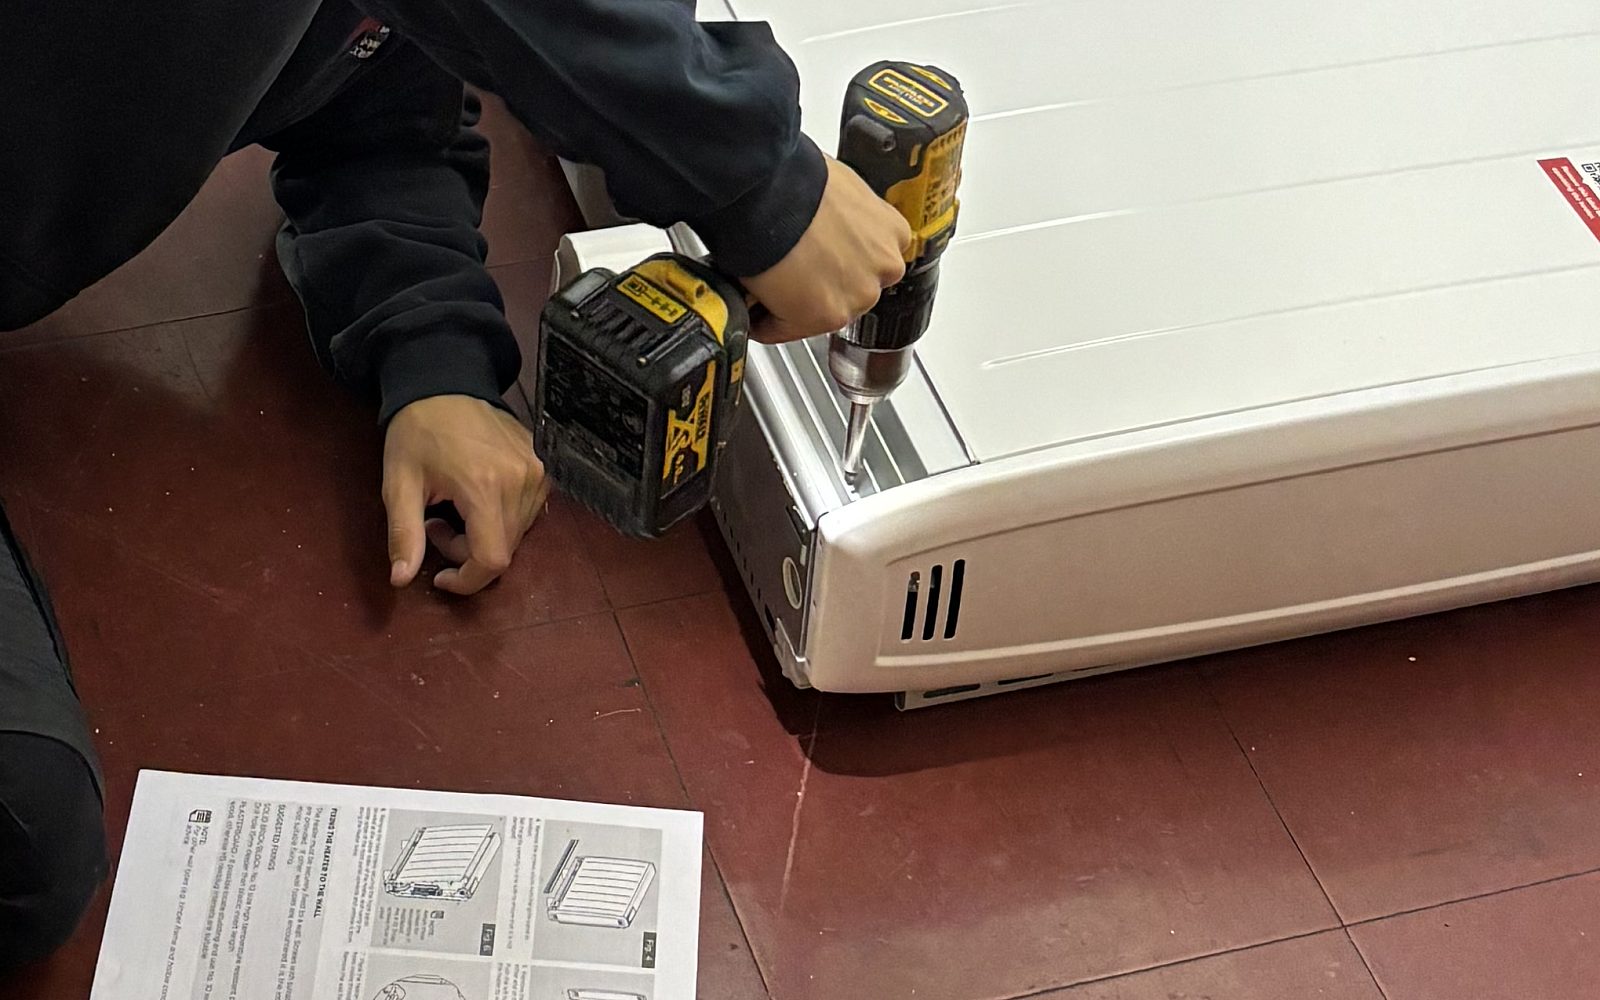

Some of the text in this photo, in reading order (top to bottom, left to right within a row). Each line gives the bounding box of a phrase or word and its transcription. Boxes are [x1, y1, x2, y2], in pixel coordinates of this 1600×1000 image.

[252, 802, 261, 814] Drill
[260, 802, 270, 822] SOLID
[294, 805, 303, 820] most
[249, 815, 258, 829] hole
[328, 807, 337, 829] FIXING
[220, 820, 233, 850] otherwise
[230, 800, 246, 854] PLASTERBOARD
[290, 821, 301, 846] suitable
[310, 818, 320, 838] heater
[188, 836, 199, 853] other
[267, 804, 285, 871] SUGGESTED FIXINGS
[308, 839, 317, 855] must
[185, 855, 195, 867] wall
[295, 855, 304, 872] other
[321, 845, 331, 871] HEATER
[182, 868, 193, 885] types
[223, 864, 234, 889] possible
[239, 871, 248, 886] than
[293, 874, 301, 886] wall
[290, 887, 298, 906] types
[317, 884, 325, 896] THE
[243, 906, 252, 921] high
[314, 897, 322, 918] WALL
[169, 924, 182, 945] frame
[235, 922, 249, 964] temperature
[280, 919, 293, 962] encountered
[167, 946, 177, 960] and
[211, 943, 220, 956] and
[276, 977, 284, 990] the
